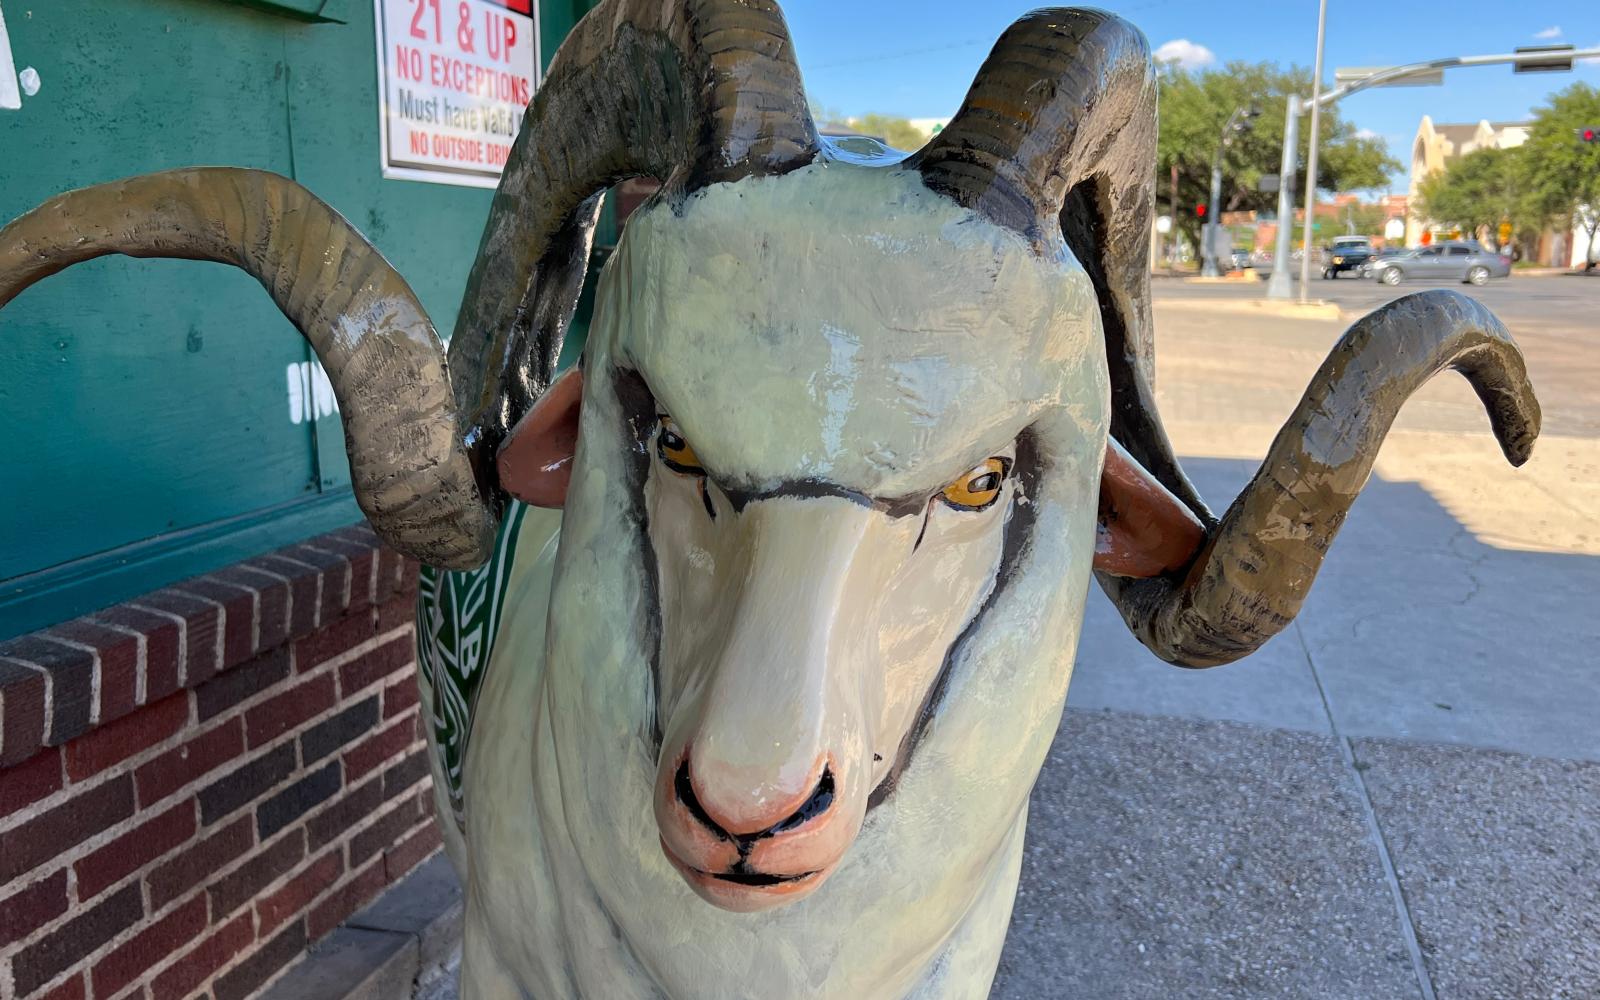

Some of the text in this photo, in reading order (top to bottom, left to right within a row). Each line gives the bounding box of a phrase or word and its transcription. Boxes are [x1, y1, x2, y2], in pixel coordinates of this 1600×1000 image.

[409, 0, 517, 63] 21 & UP
[396, 45, 529, 107] NO EXCEPTIONS
[399, 88, 439, 124] Must
[444, 98, 476, 132] have
[410, 131, 428, 156] NO
[432, 135, 483, 163] OUTSIDE
